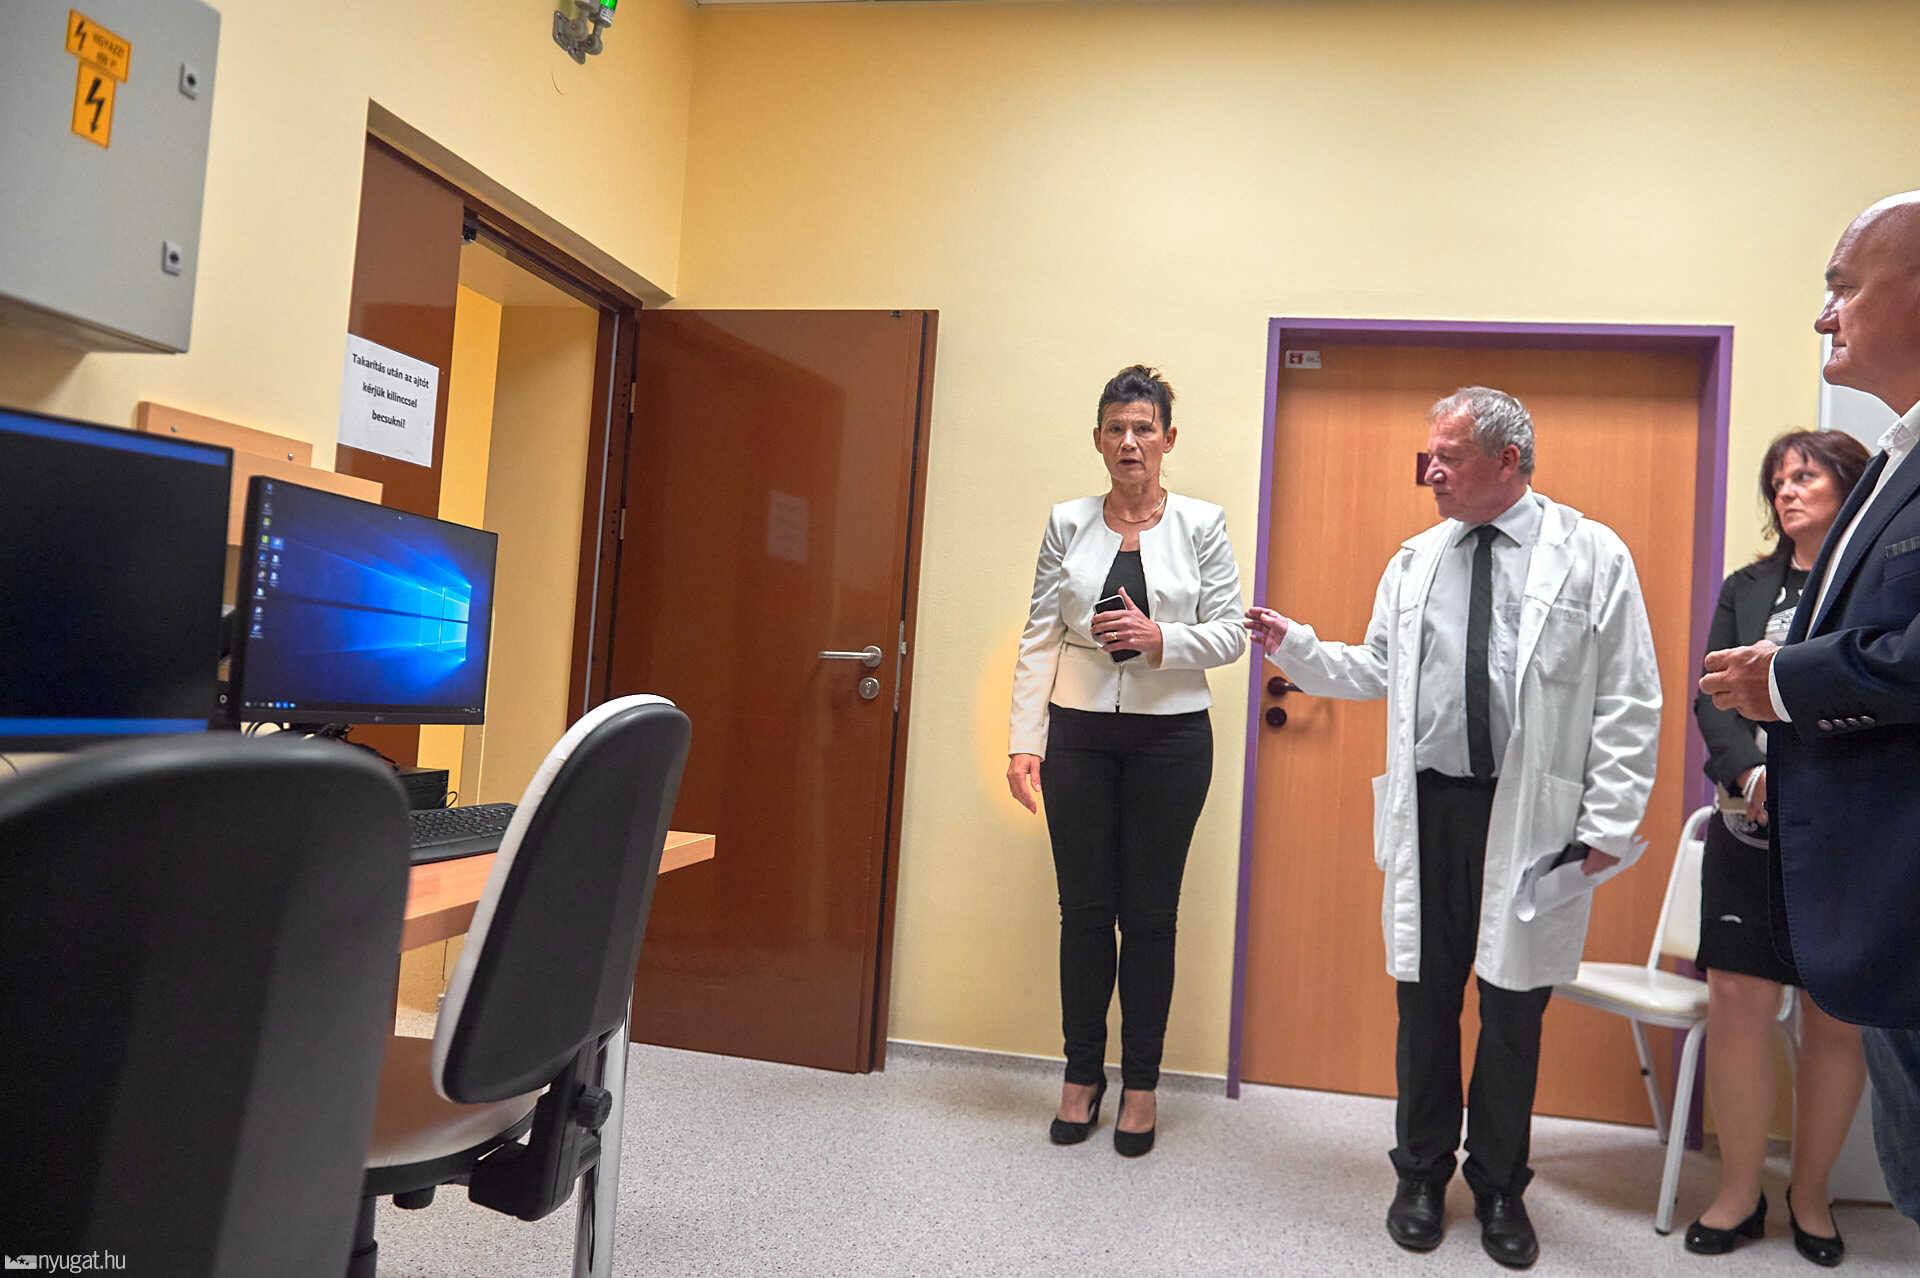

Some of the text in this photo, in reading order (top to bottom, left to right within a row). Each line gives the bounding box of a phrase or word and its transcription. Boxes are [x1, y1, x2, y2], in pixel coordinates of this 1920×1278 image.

[352, 353, 430, 389] Takarítás után az ajtót
[362, 381, 418, 408] kérjük kilinccsel
[371, 409, 406, 429] becsukni!
